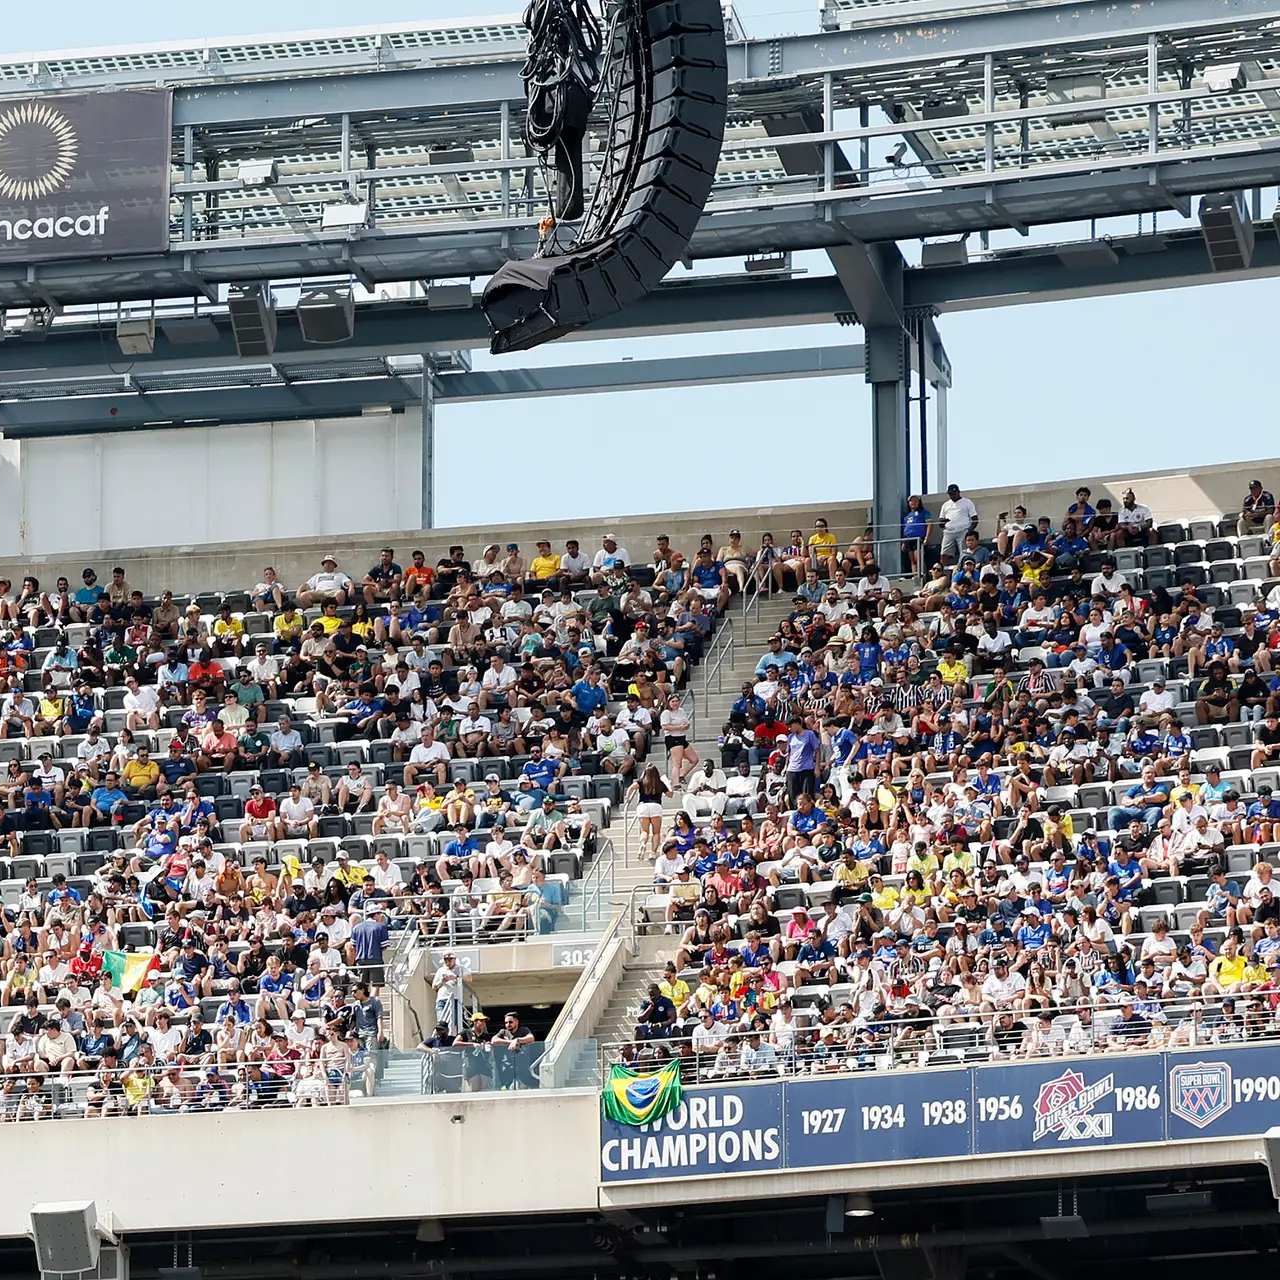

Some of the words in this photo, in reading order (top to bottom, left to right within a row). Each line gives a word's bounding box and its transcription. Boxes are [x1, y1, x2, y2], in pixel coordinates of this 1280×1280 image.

[1180, 1074, 1200, 1087] SUPER
[1201, 1072, 1221, 1085] BOWL
[1233, 1076, 1280, 1103] 1990
[1073, 1075, 1114, 1112] BOWL
[1113, 1084, 1161, 1112] 1986
[1180, 1087, 1221, 1112] XXV
[801, 1108, 846, 1135] 1927
[861, 1104, 906, 1131] 1934
[921, 1099, 967, 1127] 1938
[977, 1096, 1023, 1122] 1956
[1060, 1112, 1114, 1139] XXI
[602, 1128, 780, 1172] CHAMPIONS
